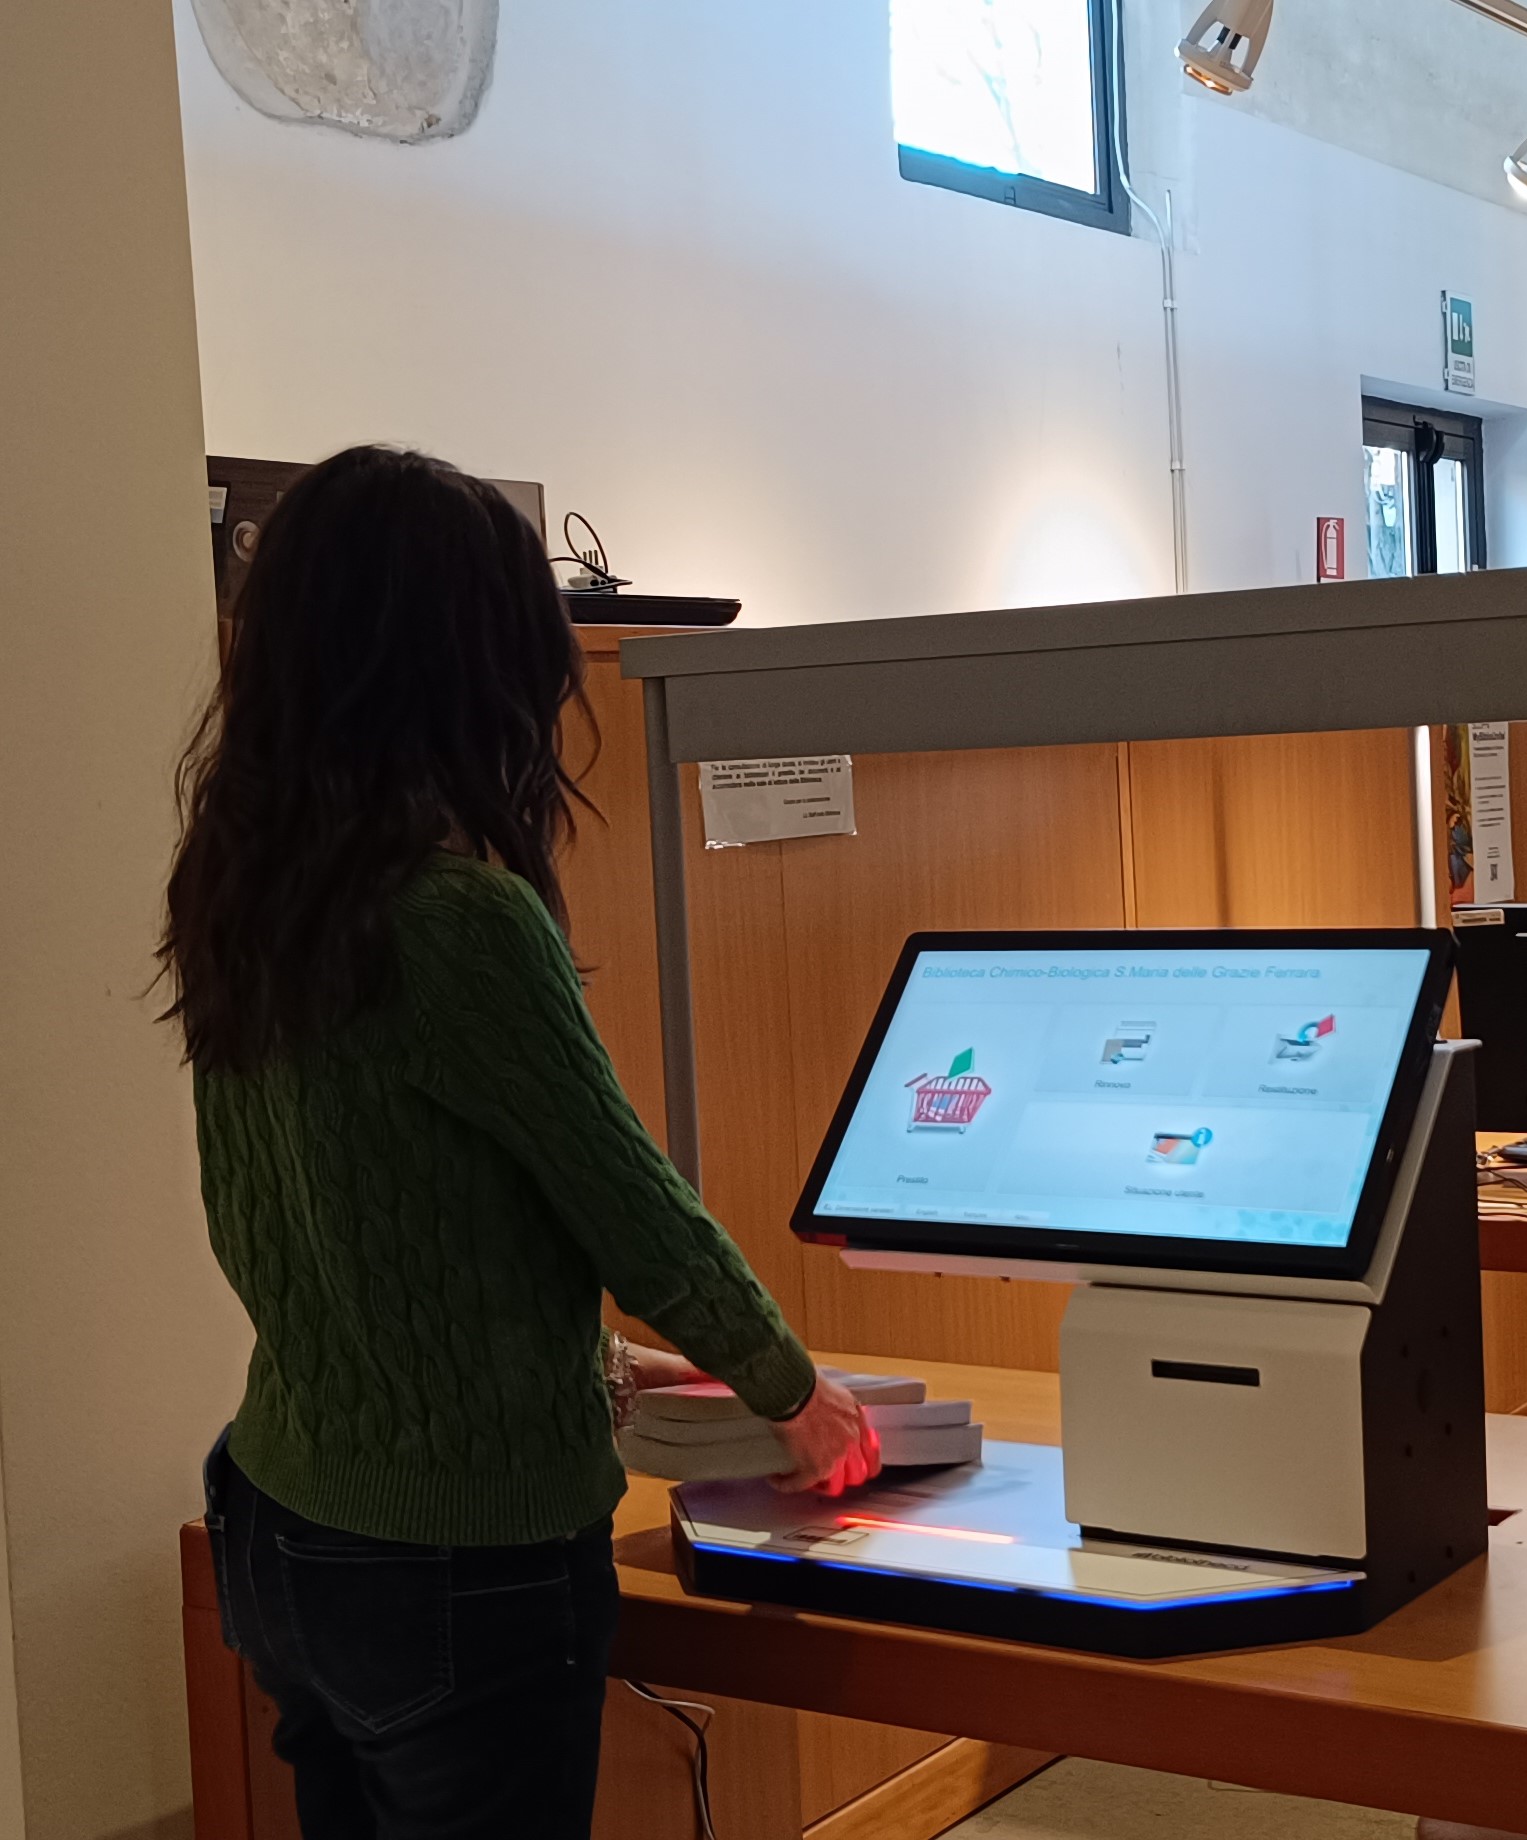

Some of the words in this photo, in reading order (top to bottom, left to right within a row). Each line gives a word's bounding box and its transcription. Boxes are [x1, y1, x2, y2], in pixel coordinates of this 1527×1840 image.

[922, 966, 985, 978] Biblioteca
[989, 966, 1110, 980] Chimico-Biologica
[1172, 966, 1207, 978] delle
[1212, 966, 1261, 978] Grazie
[1264, 966, 1321, 978] Ferrara
